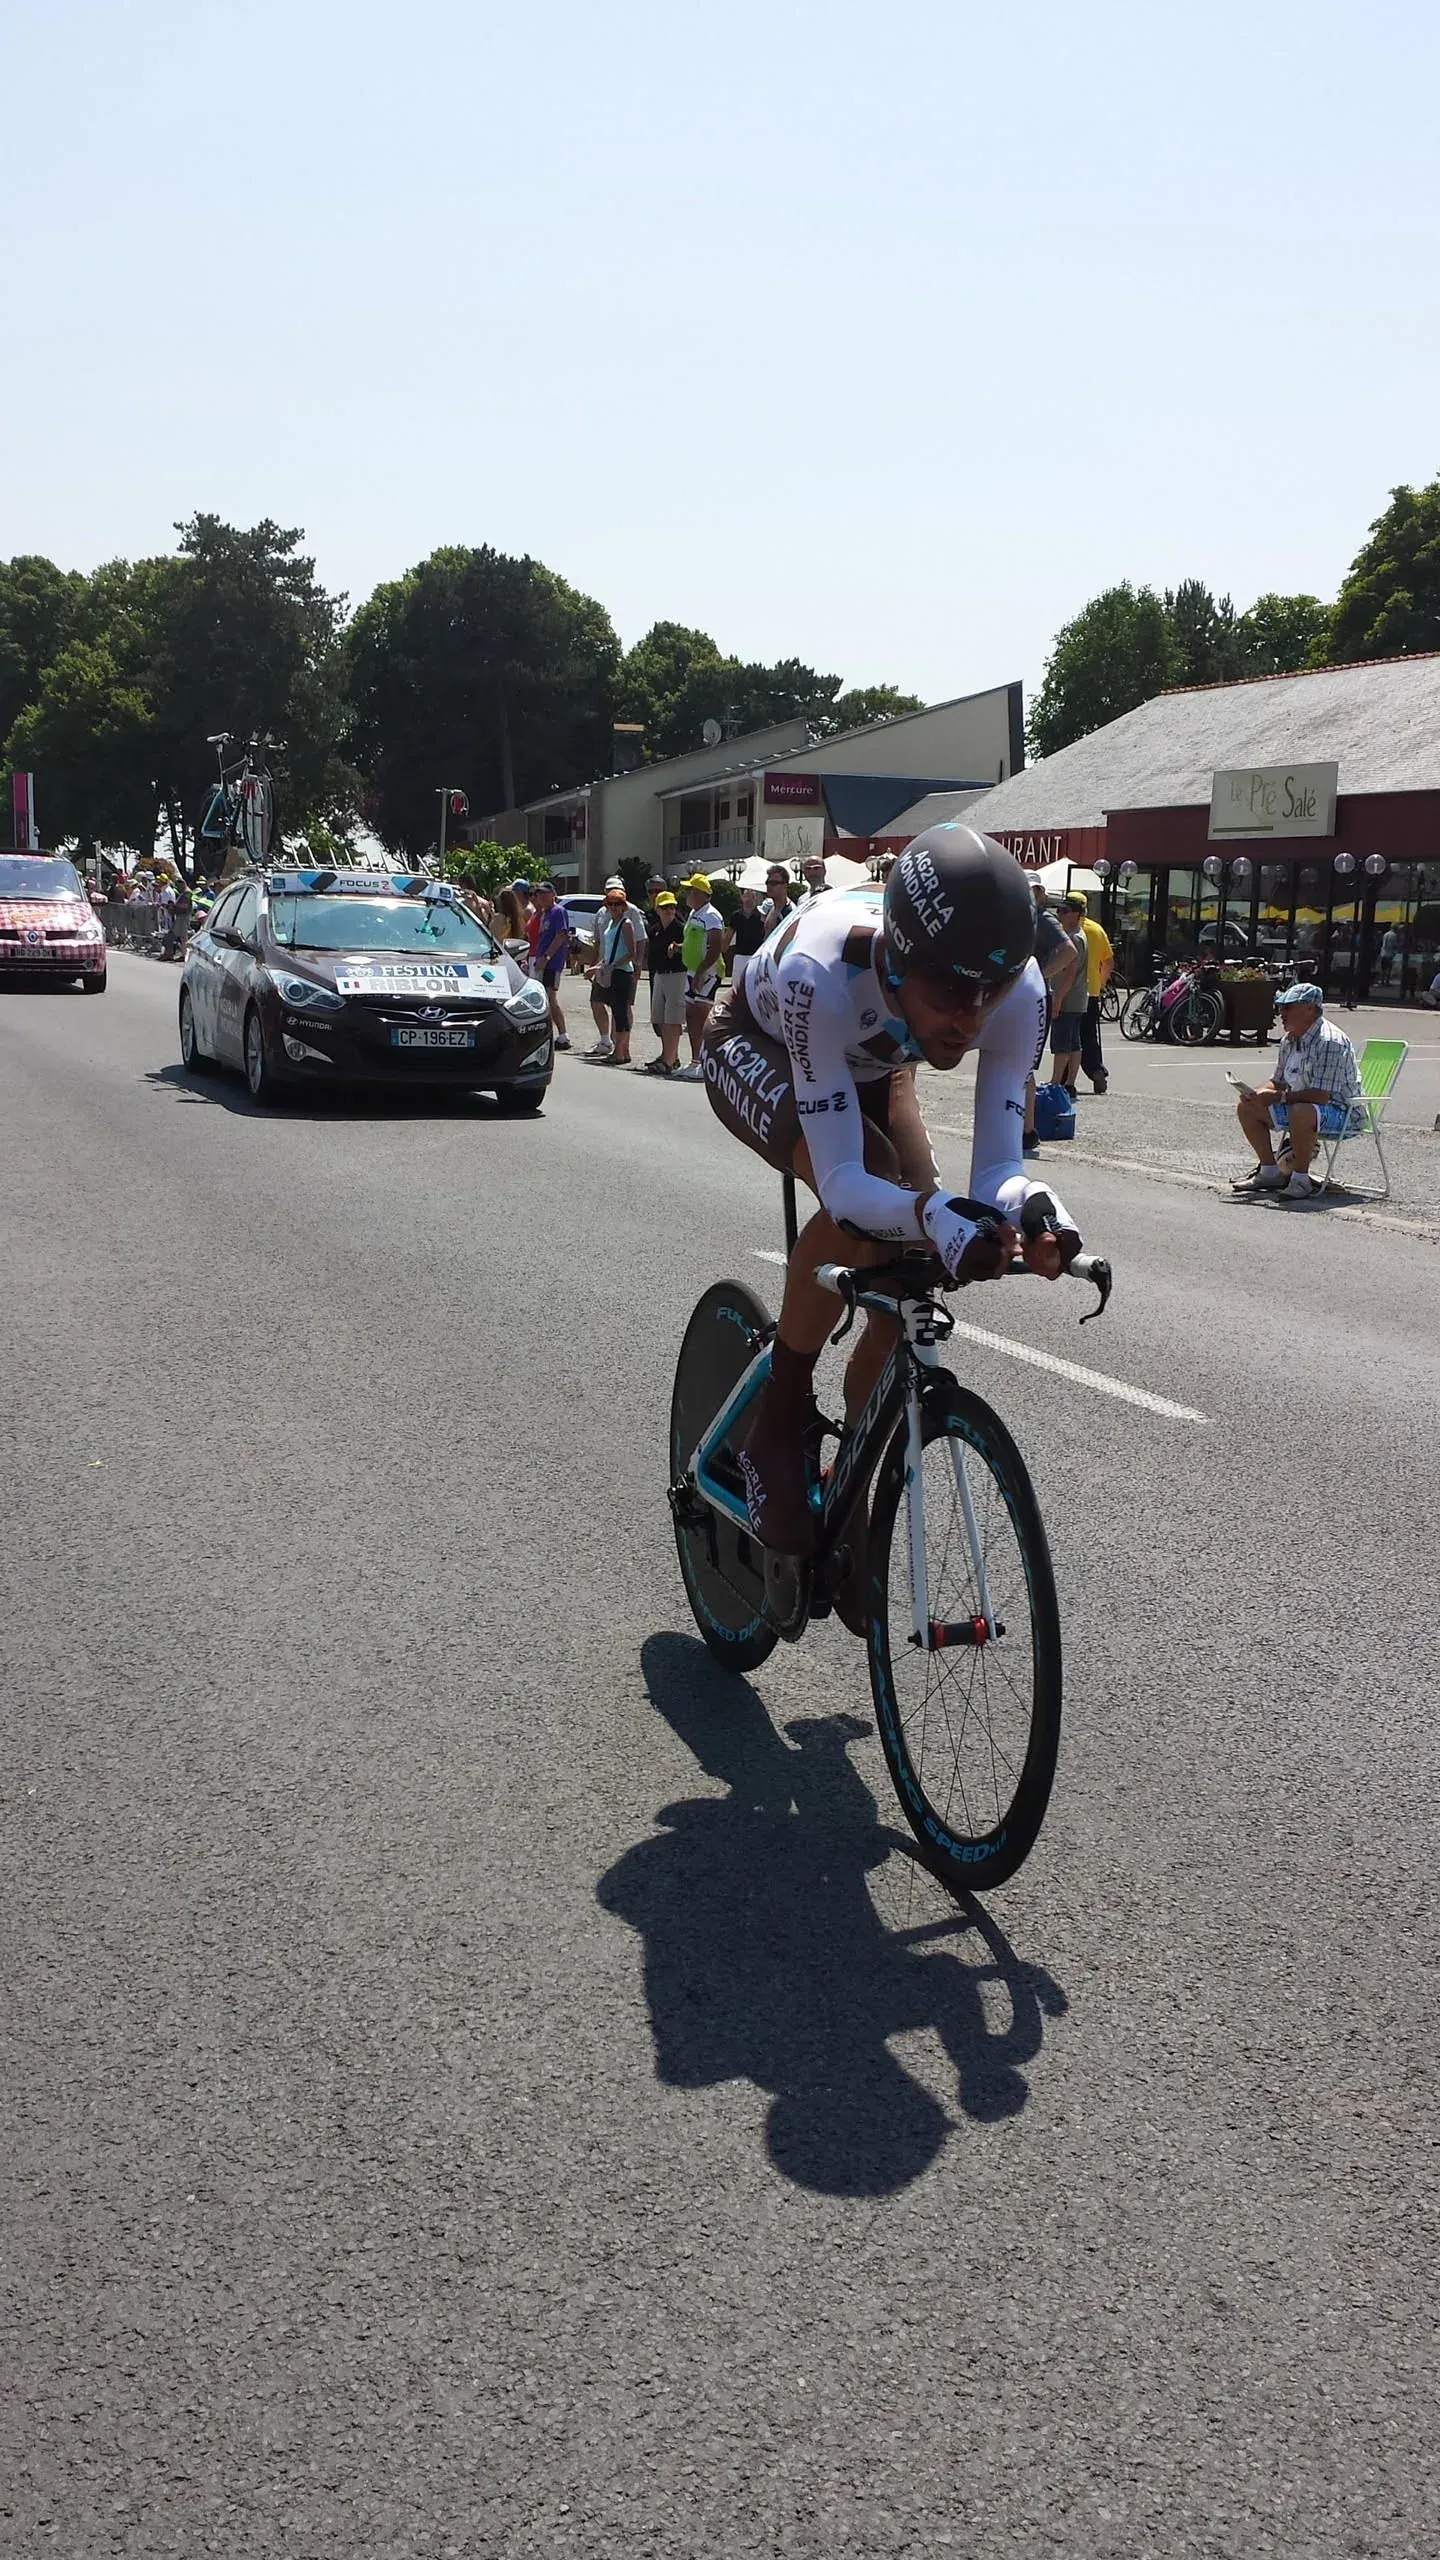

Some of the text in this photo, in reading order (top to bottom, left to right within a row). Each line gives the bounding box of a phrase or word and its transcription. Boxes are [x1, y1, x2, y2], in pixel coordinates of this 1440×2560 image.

[770, 783, 814, 796] Mercure
[1282, 775, 1317, 819] Salé
[339, 880, 380, 888] FOCUS
[899, 850, 943, 939] MONDIALE
[914, 850, 956, 925] AG2R LA
[369, 978, 460, 993] RIBLON
[382, 964, 460, 977] FESTINA
[784, 980, 800, 1008] LA
[299, 1019, 333, 1031] HYUNDAI
[794, 983, 817, 1083] MONDIALE
[715, 1033, 790, 1112] AG2R LA
[735, 1450, 760, 1487] AG2R
[922, 1816, 990, 1865] SPEED
